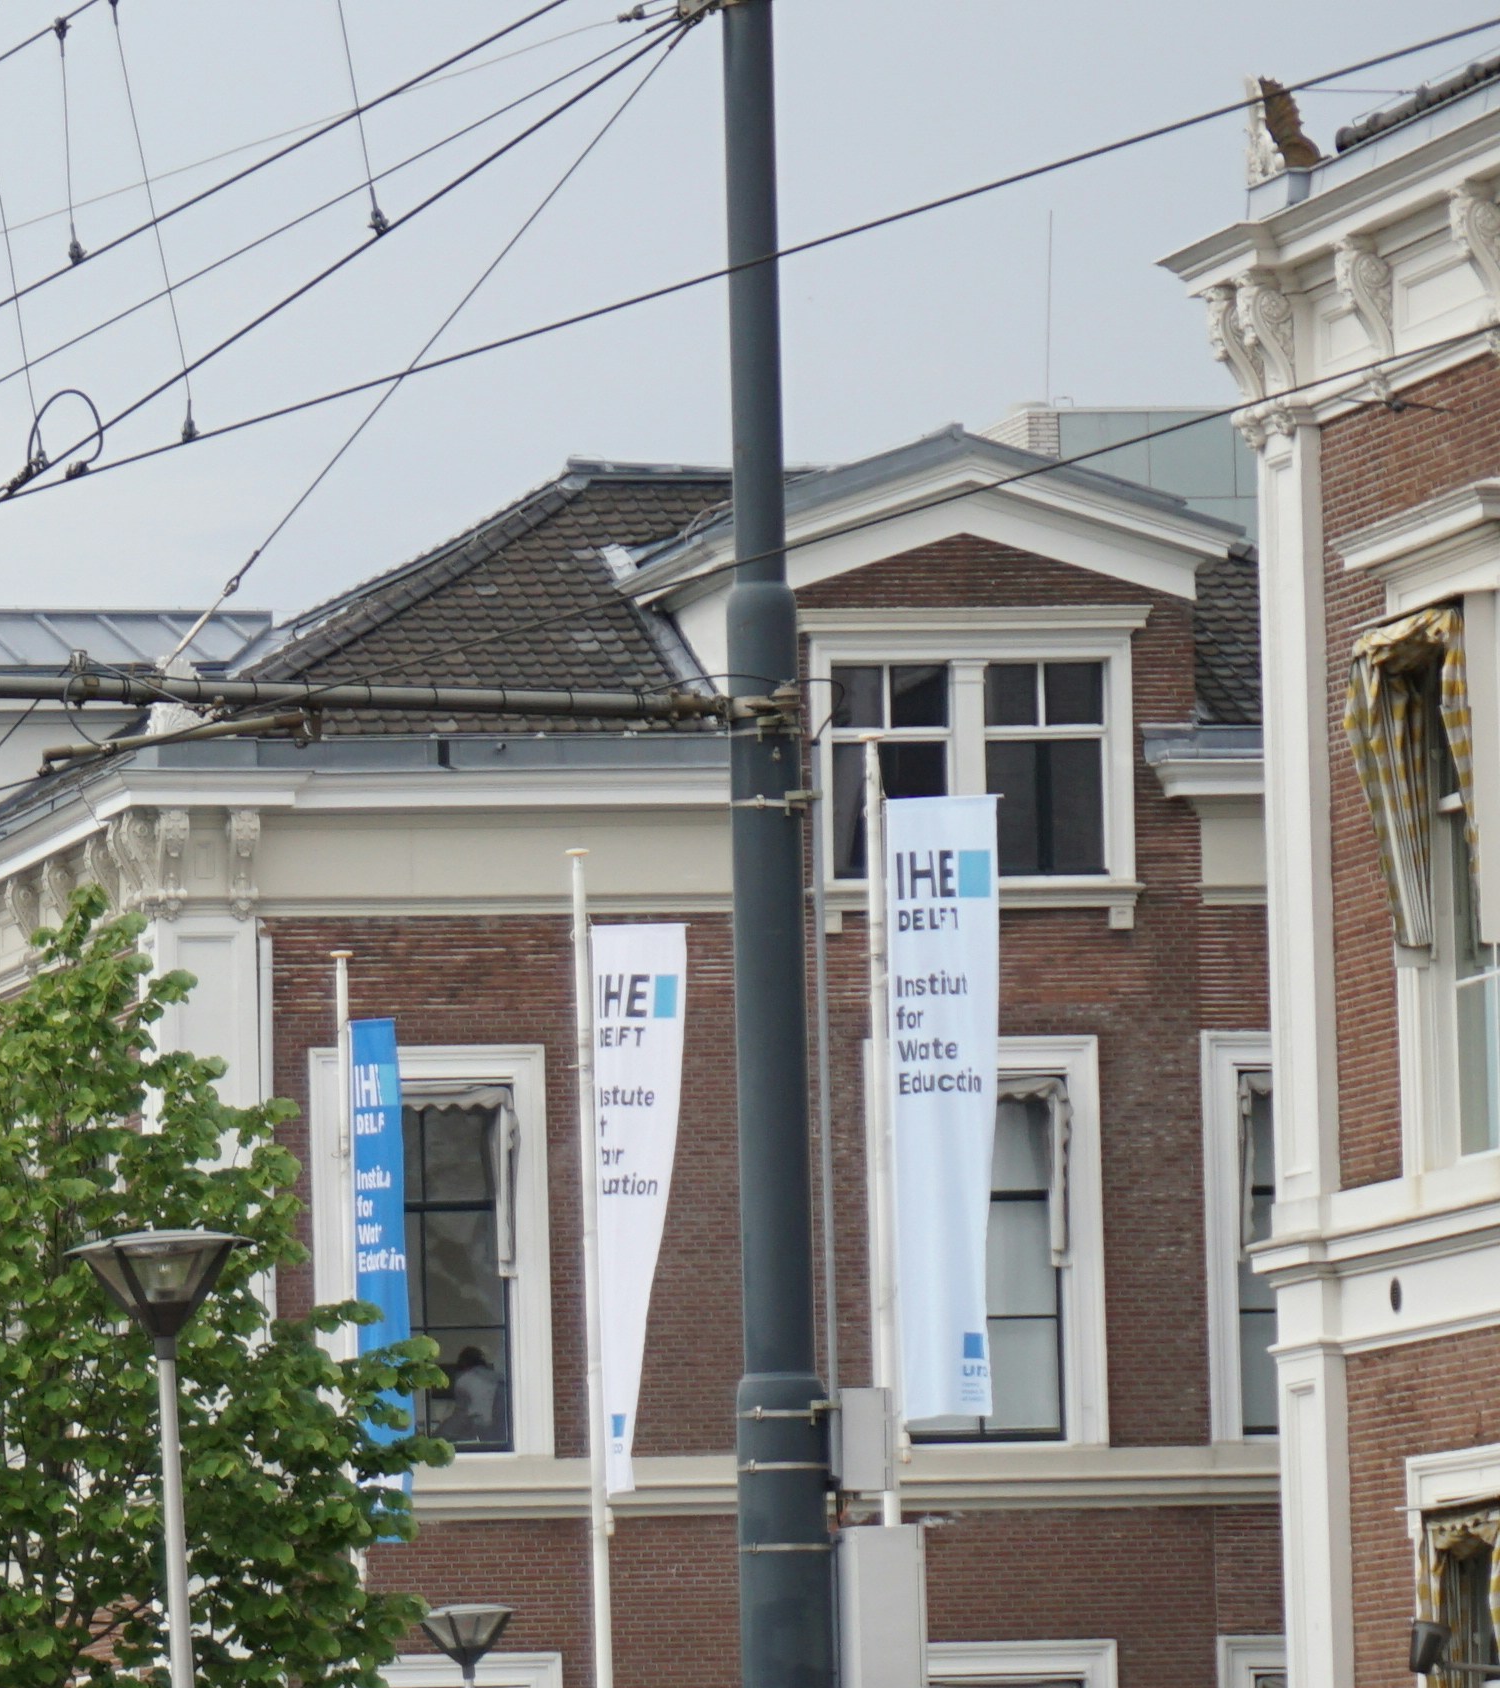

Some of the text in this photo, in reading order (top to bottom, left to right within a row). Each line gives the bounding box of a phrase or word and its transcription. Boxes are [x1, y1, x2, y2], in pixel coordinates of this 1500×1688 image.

[896, 850, 957, 900] IHE
[896, 1005, 924, 1030] for
[897, 1037, 958, 1063] Wate
